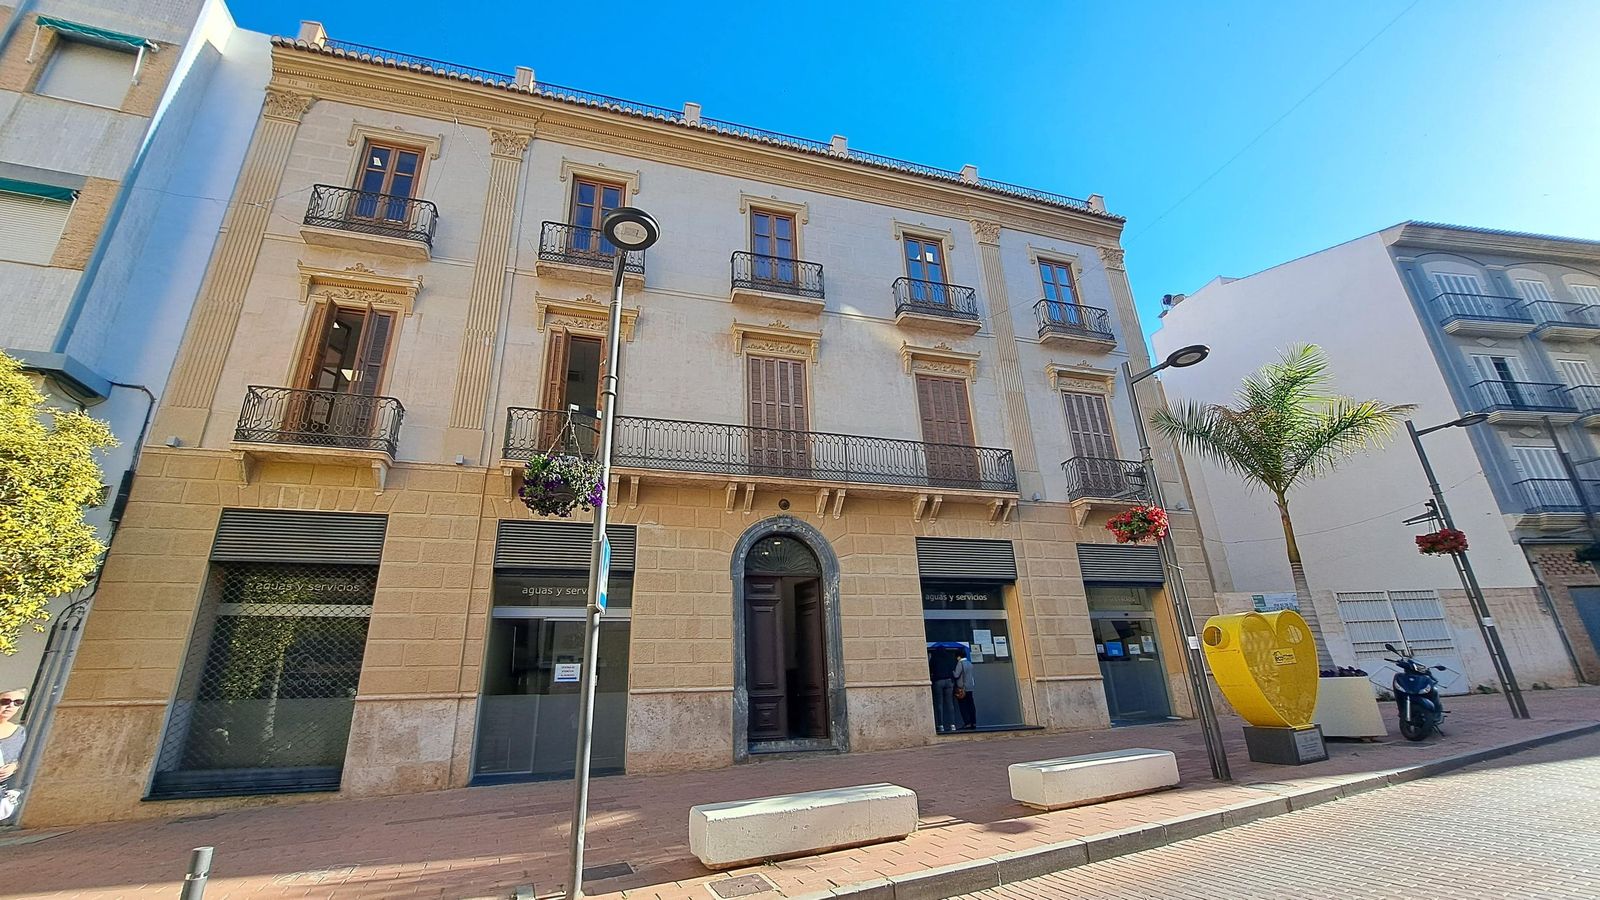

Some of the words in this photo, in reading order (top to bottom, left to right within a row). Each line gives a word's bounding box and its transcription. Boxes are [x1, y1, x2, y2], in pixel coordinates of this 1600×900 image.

[307, 582, 360, 592] servicios
[522, 587, 553, 596] aguas
[555, 587, 563, 597] y
[565, 587, 588, 595] serv
[925, 594, 948, 602] aguas
[949, 594, 954, 602] y
[955, 593, 988, 601] servicios
